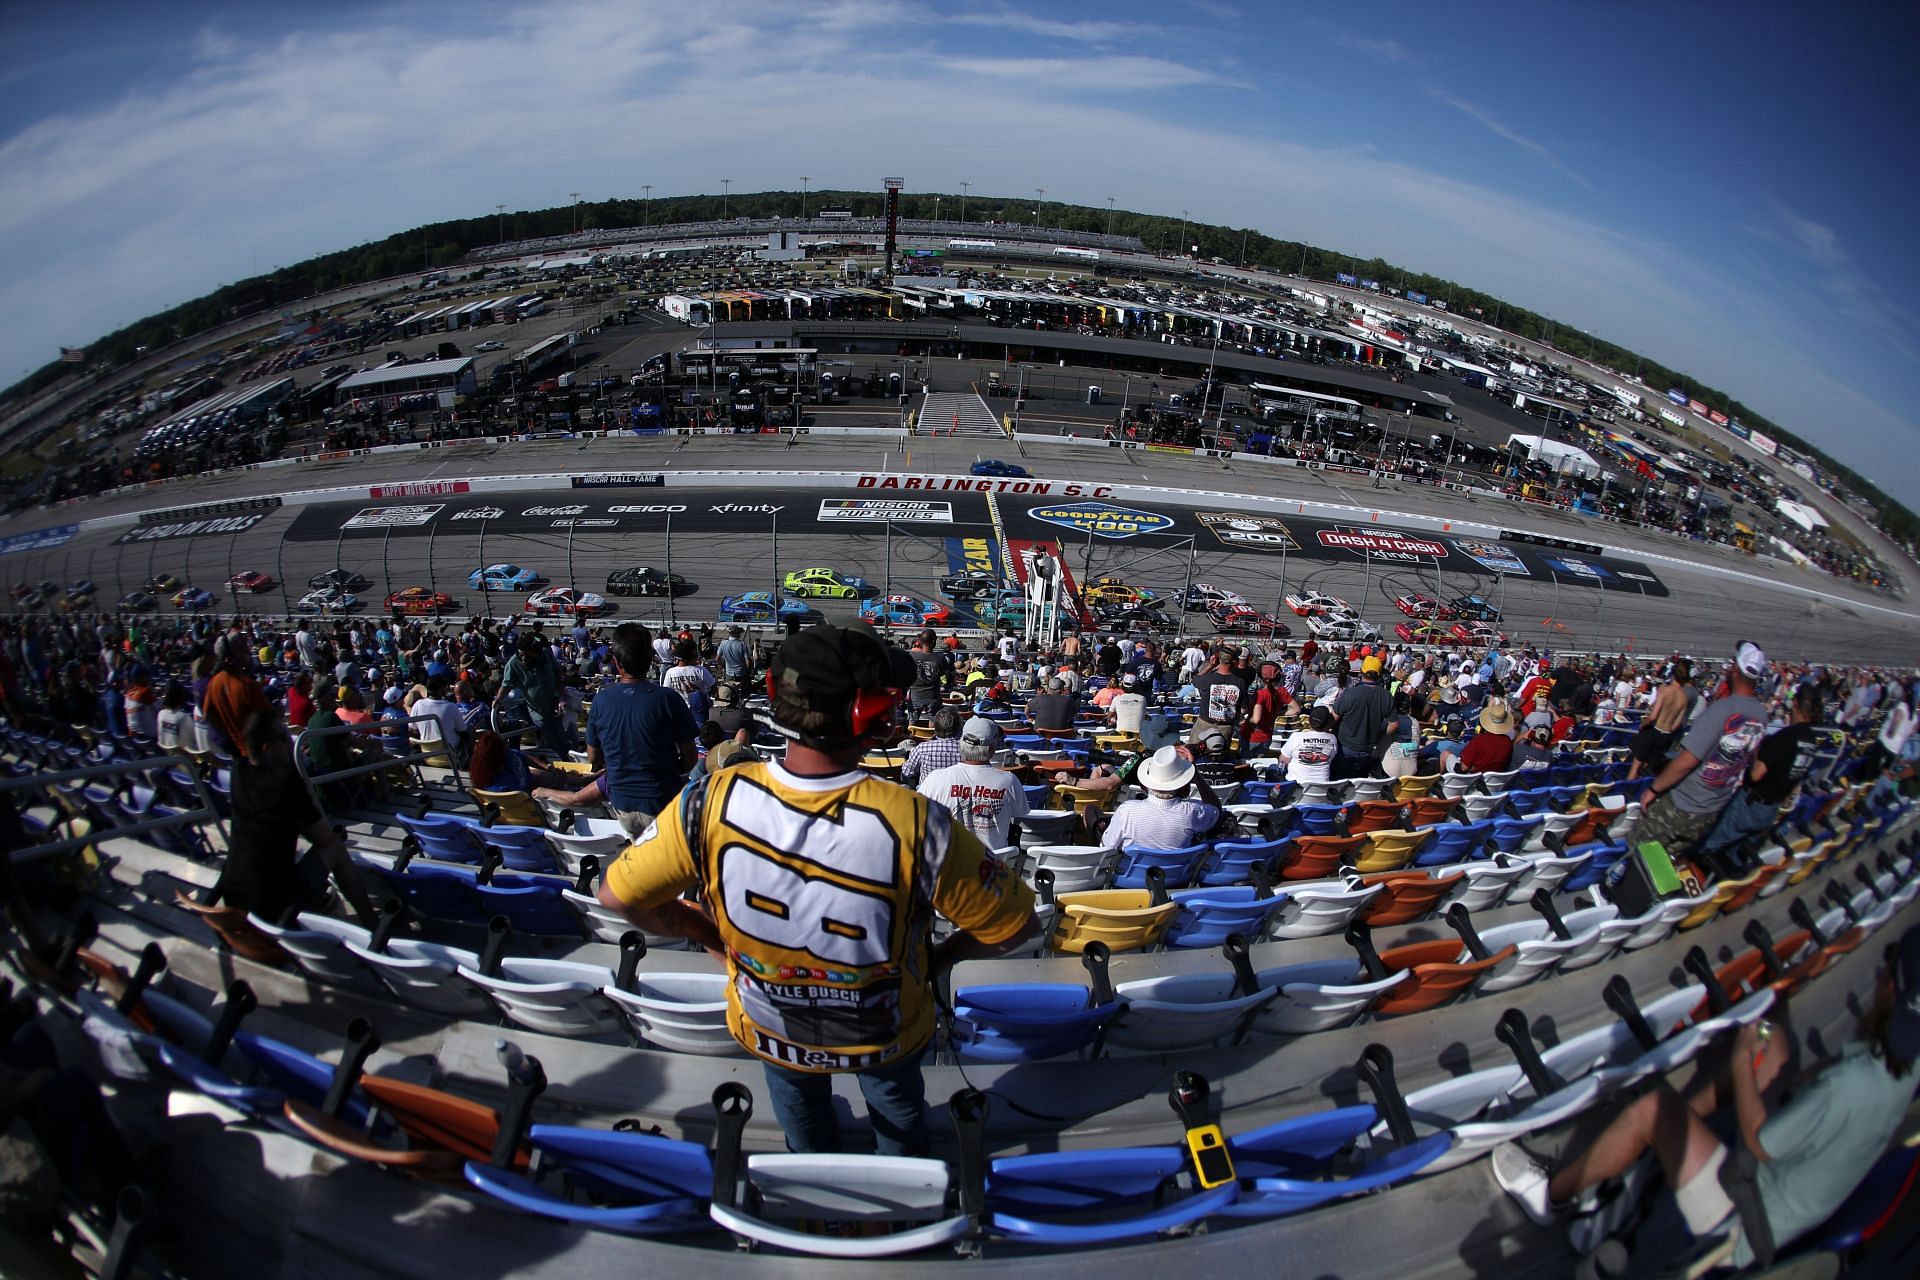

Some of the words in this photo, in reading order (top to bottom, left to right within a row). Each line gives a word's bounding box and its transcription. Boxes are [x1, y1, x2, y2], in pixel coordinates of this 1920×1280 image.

[584, 476, 608, 484] NASCAR
[382, 487, 401, 497] HAPPY
[405, 484, 439, 496] MOTHER'S
[441, 482, 455, 494] DAY
[857, 476, 1051, 494] DARLINGTON
[1064, 485, 1118, 499] S.C.
[608, 505, 687, 513] GEICO
[708, 504, 784, 514] xfinity
[863, 501, 930, 510] NASCAR
[450, 511, 502, 520] BUSCH
[836, 510, 873, 518] CUP
[875, 511, 934, 519] SERIES
[1039, 510, 1160, 523] GOODYEAR
[199, 514, 263, 534] TOOLS
[1075, 520, 1138, 531] 400
[1201, 515, 1282, 527] STEAKHOUSE
[1228, 532, 1281, 542] 200
[1361, 529, 1403, 539] NASCAR
[1325, 534, 1377, 547] DASH
[1379, 540, 1392, 548] 4
[1393, 541, 1440, 553] CASH
[1369, 550, 1419, 562] xfinity
[820, 585, 832, 595] 21
[975, 588, 988, 597] 6
[754, 611, 769, 621] 17
[900, 614, 915, 624] 43
[1249, 623, 1260, 632] 20
[951, 785, 970, 800] Big
[973, 785, 1006, 800] Head
[763, 982, 803, 998] KYLE
[809, 987, 860, 1002] BUSCH
